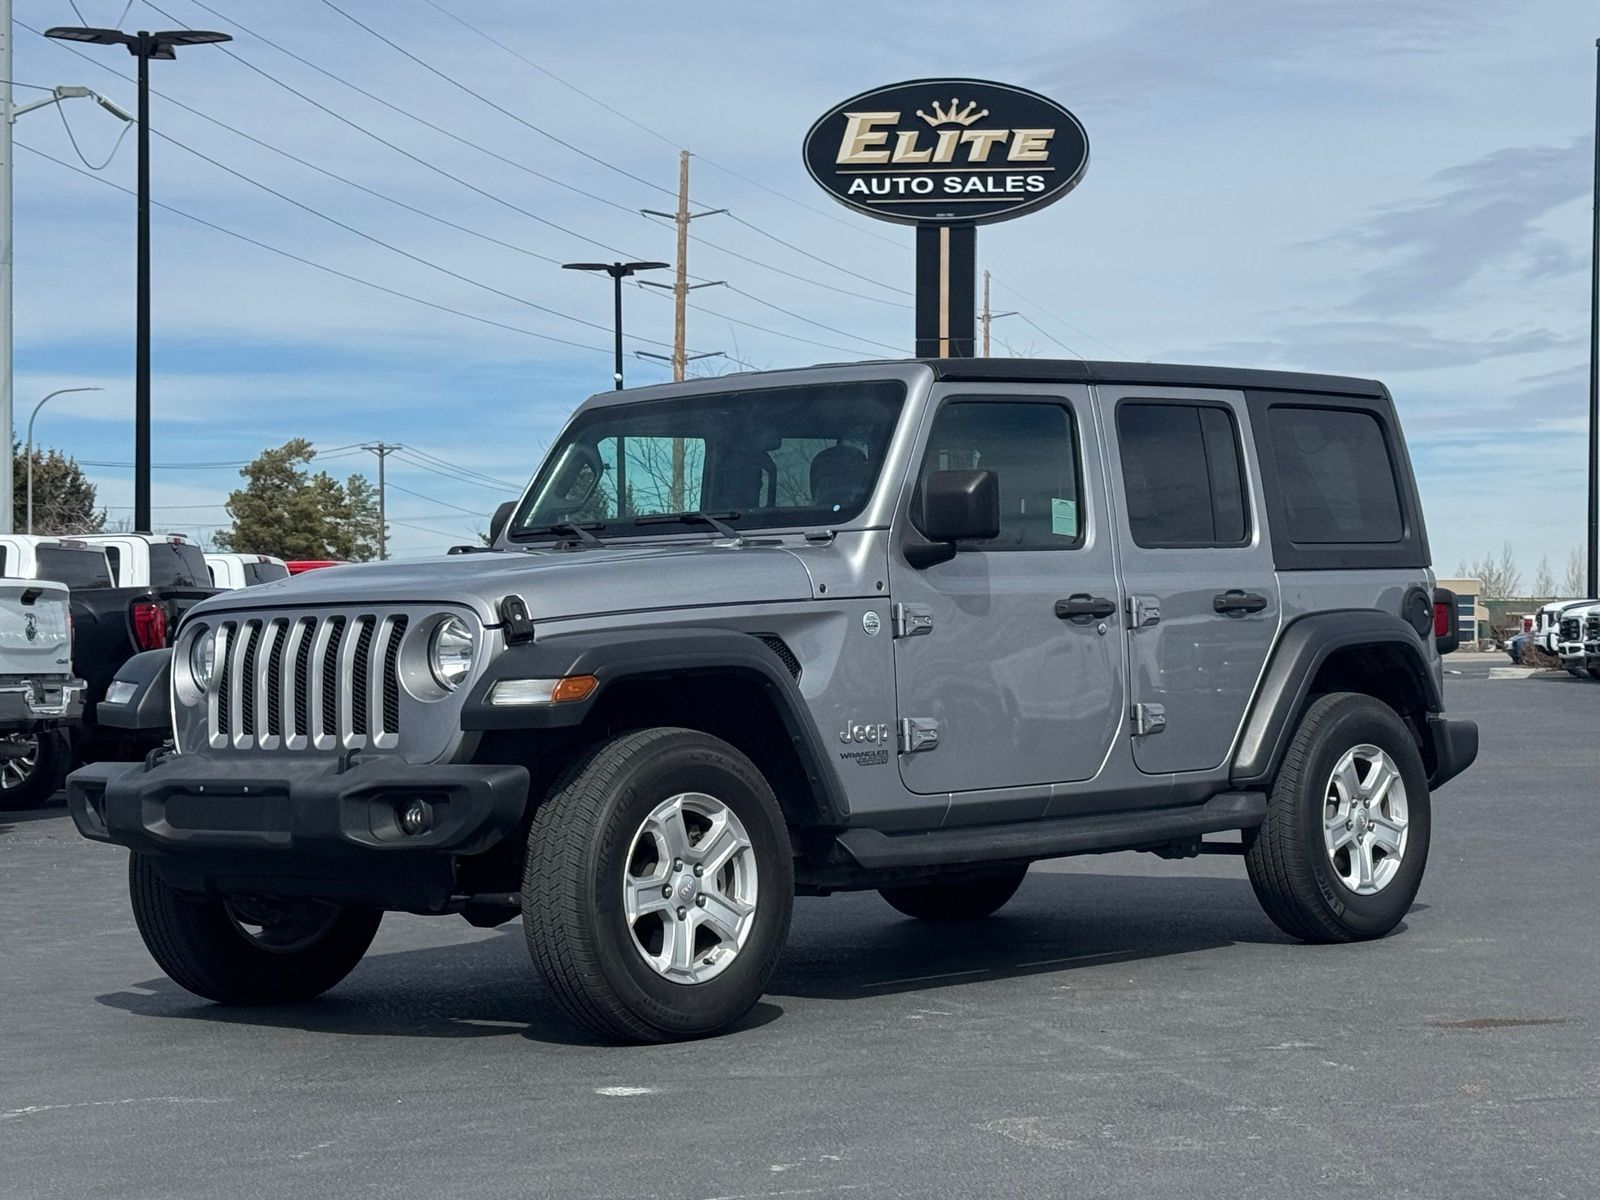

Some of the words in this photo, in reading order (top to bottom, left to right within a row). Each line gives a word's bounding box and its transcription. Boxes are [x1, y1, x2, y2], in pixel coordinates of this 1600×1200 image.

[835, 111, 1056, 164] ELITE
[848, 177, 934, 195] AUTO
[943, 175, 1045, 193] SALES
[839, 720, 889, 746] Jeep
